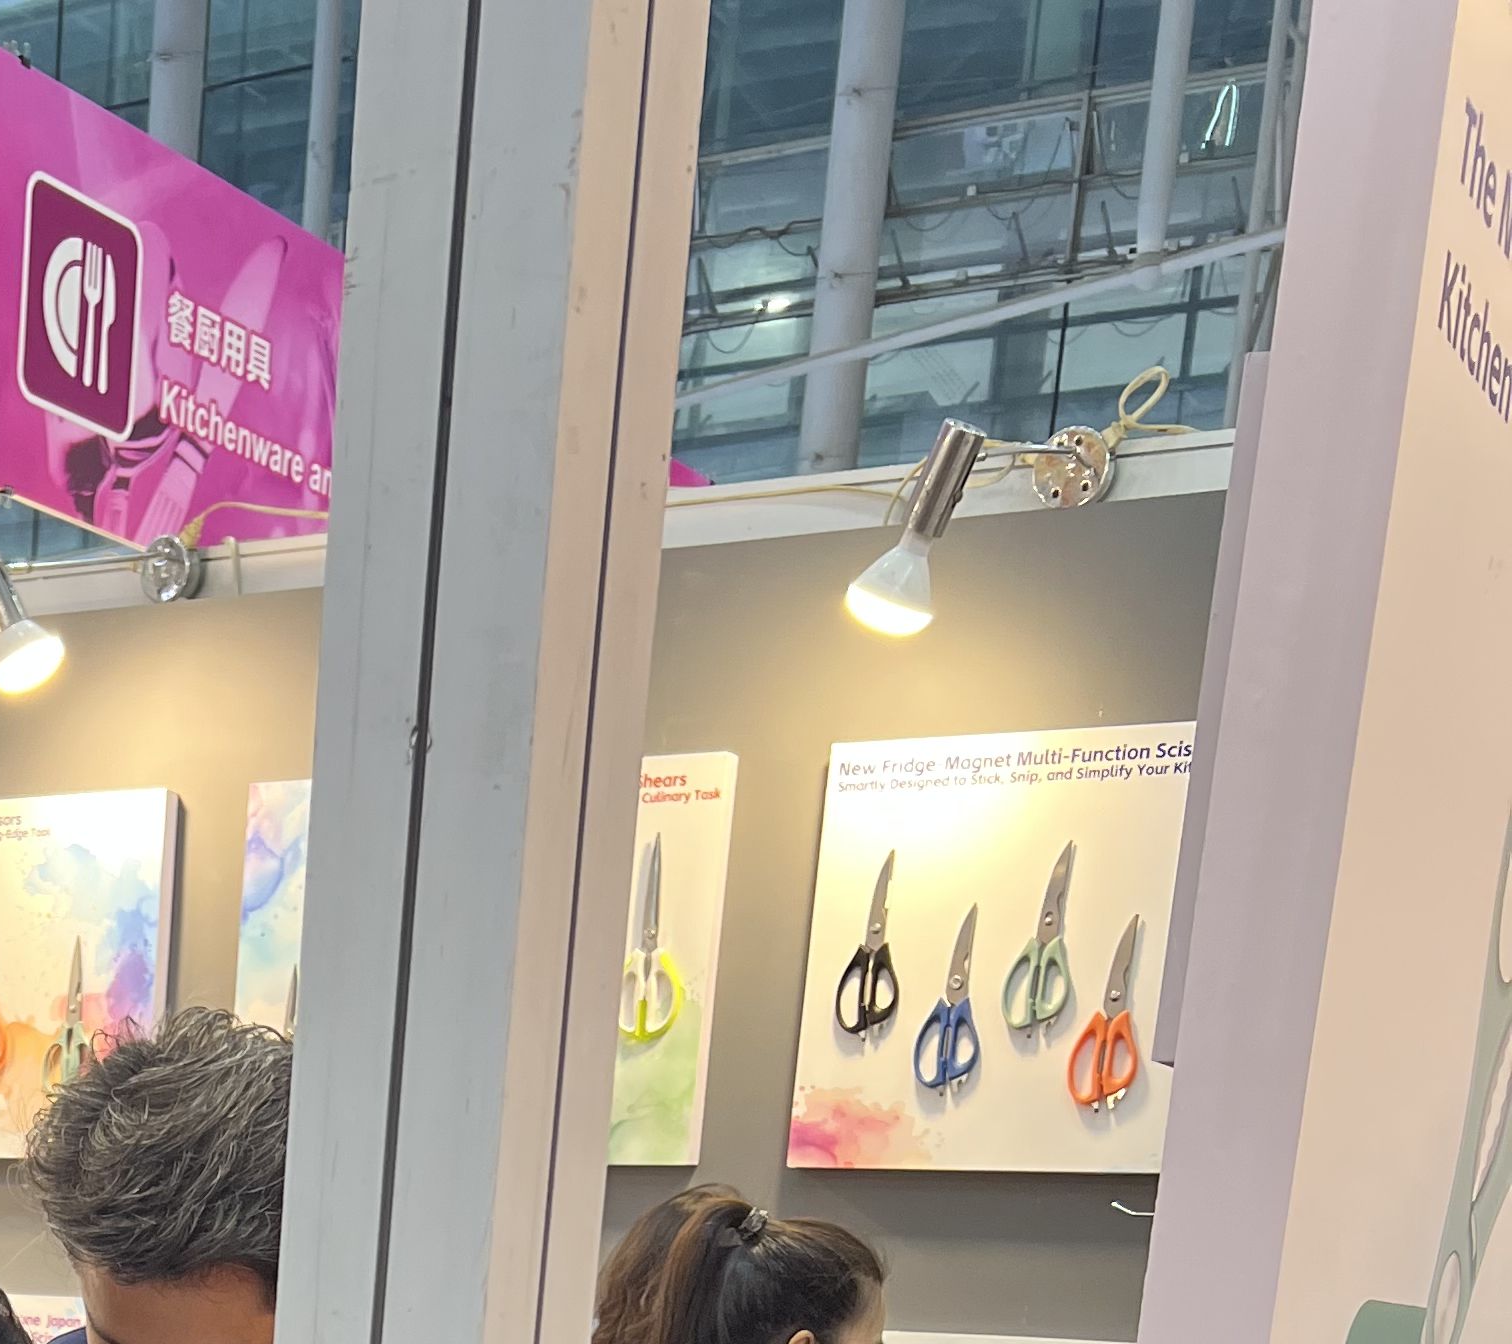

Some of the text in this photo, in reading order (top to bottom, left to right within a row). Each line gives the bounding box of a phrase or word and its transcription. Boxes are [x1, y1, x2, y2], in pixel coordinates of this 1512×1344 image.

[1461, 98, 1496, 229] The
[167, 290, 272, 391] 餐厨用具
[1438, 250, 1512, 424] Kitchen
[159, 379, 305, 484] Kitchenware
[642, 787, 722, 804] Culinary Task
[838, 780, 886, 793] Smartly
[890, 776, 950, 791] Designed
[954, 775, 967, 786] to
[1010, 770, 1044, 786] Snip,
[1047, 766, 1073, 781] and
[1076, 765, 1134, 782] Simplify
[1137, 763, 1170, 776] Your
[839, 762, 876, 776] New
[882, 758, 936, 776] Fridge
[945, 753, 1012, 774] Magnet
[1016, 743, 1151, 767] Multi-Function
